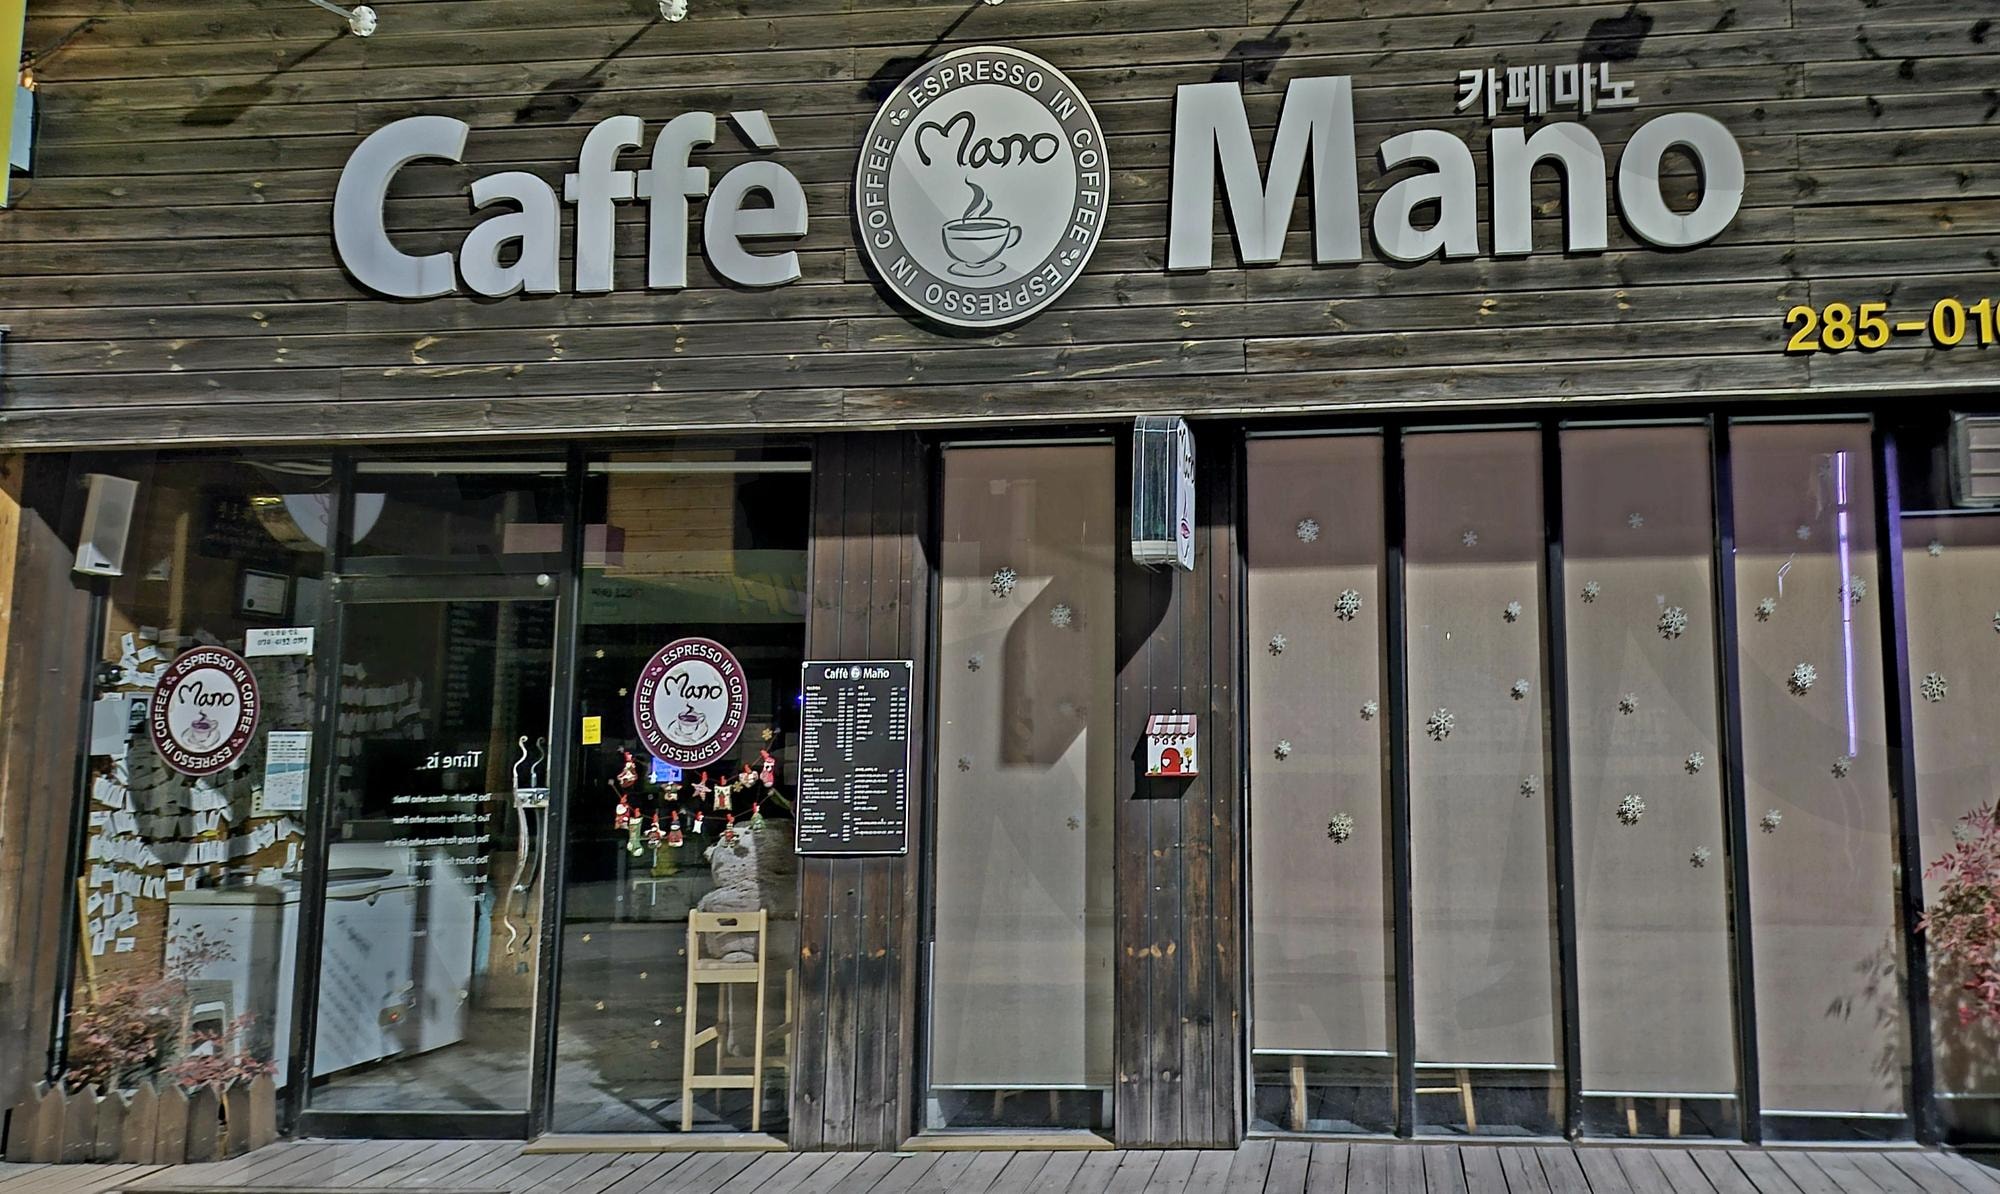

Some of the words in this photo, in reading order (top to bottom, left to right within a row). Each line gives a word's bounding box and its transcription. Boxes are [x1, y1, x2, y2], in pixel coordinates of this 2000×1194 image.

[1457, 62, 1639, 118] 카페마노
[907, 60, 1044, 108] ESPRESSO
[1048, 89, 1077, 121] IN
[1069, 128, 1100, 246] COFFEE
[914, 110, 1060, 170] Mano
[333, 110, 808, 299] Caffè
[1168, 75, 1745, 270] Mano
[865, 134, 895, 249] COFFEE
[889, 255, 918, 287] IN
[925, 265, 1063, 315] ESPRESSO
[1785, 298, 2000, 352] 285-01
[176, 652, 235, 675] ESPRESSO
[233, 667, 247, 682] IN
[240, 683, 254, 734] COFFEE
[179, 681, 235, 707] Mano
[661, 644, 722, 666] ESPRESSO
[720, 659, 735, 676] IN
[729, 676, 743, 728] COFFEE
[664, 672, 722, 700] Mano
[824, 667, 849, 680] Caffè
[154, 687, 170, 738] COFFEE
[639, 678, 655, 730] COFFEE
[161, 738, 176, 755] IN
[173, 746, 233, 769] ESPRESSO
[647, 730, 662, 747] IN
[660, 741, 721, 762] ESPRESSO
[1153, 737, 1187, 746] POST
